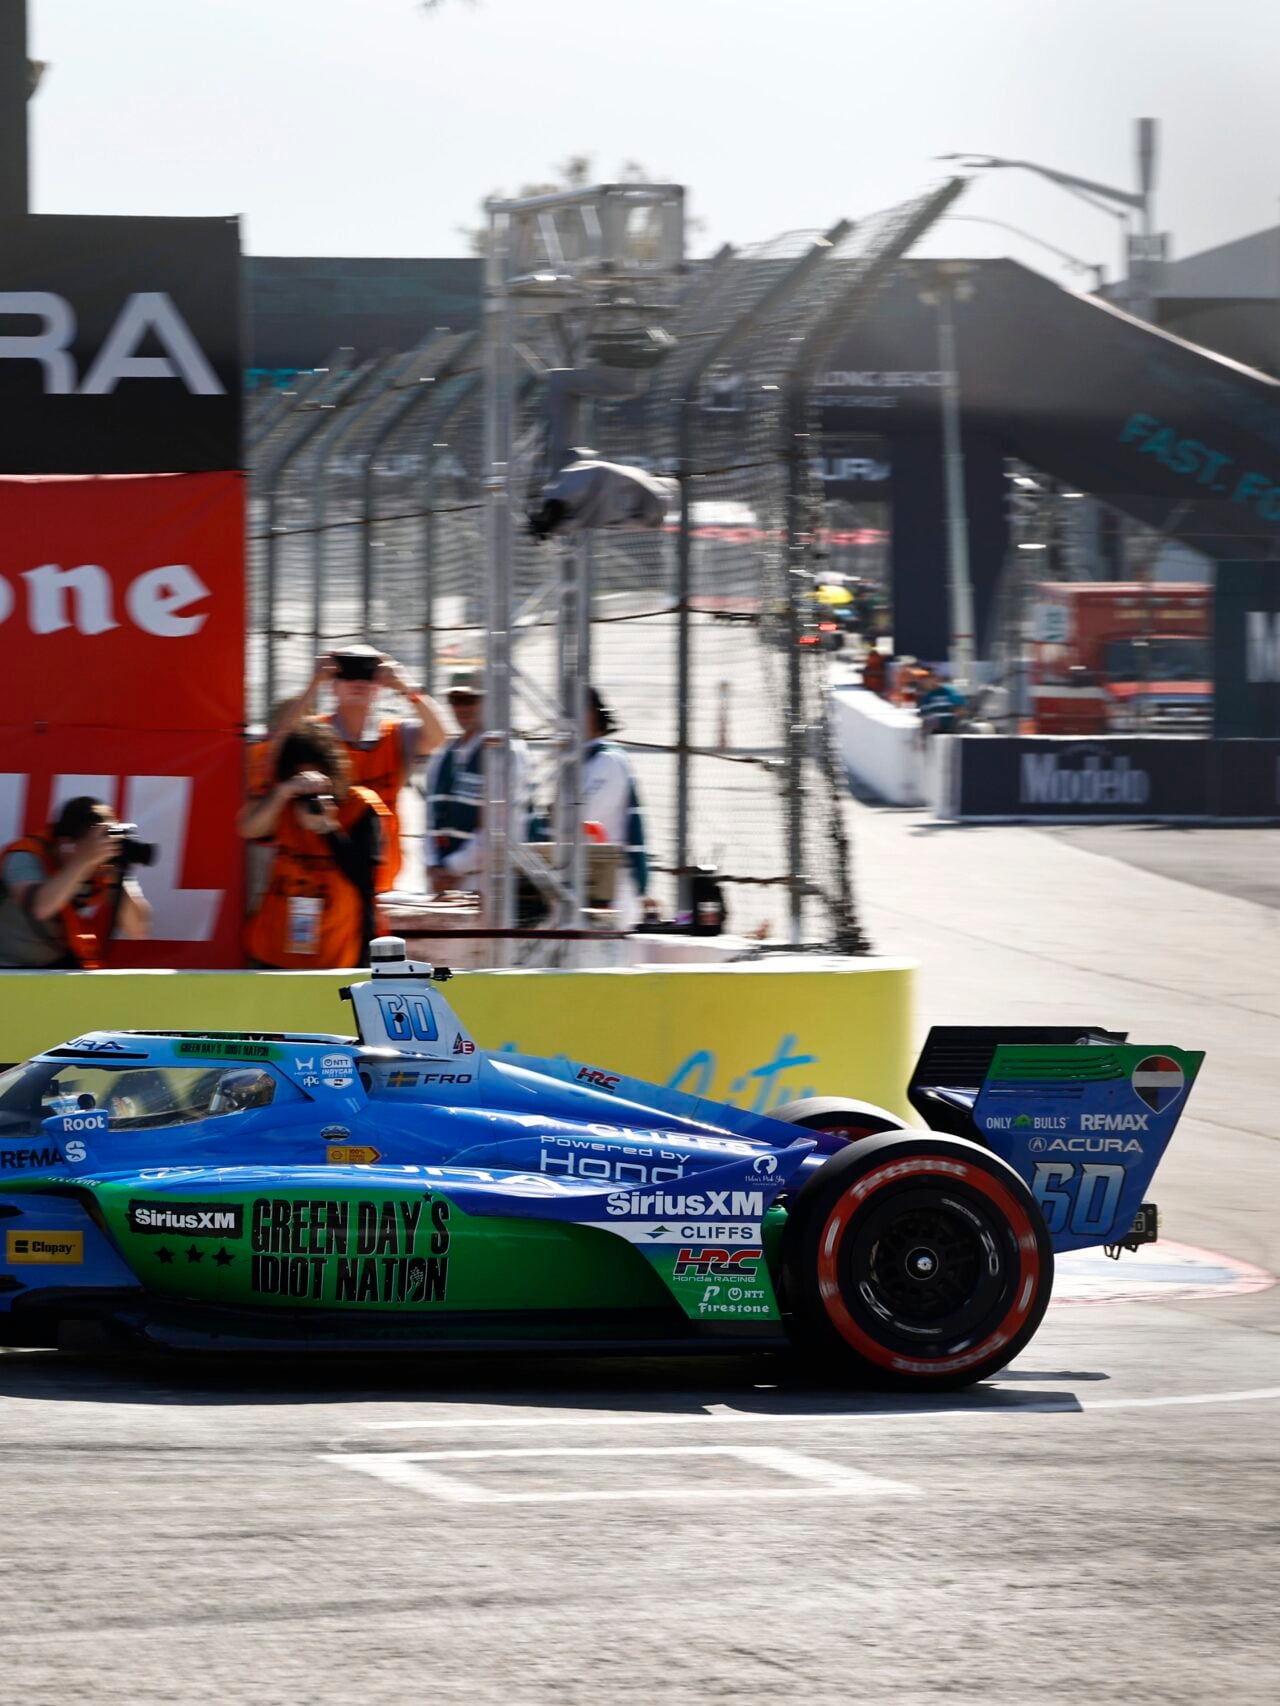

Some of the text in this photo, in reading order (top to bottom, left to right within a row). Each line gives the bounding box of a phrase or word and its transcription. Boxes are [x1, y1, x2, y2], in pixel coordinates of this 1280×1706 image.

[374, 994, 439, 1042] 60
[424, 1074, 472, 1084] FRO
[575, 1068, 621, 1090] HRC
[986, 1117, 1012, 1129] ONLY
[540, 1135, 691, 1163] Powered by
[1047, 1138, 1144, 1153] ACURA
[0, 1148, 65, 1169] REMA
[540, 1149, 704, 1185] Hond
[606, 1191, 763, 1216] SiriusXM
[1032, 1161, 1127, 1236] 60
[135, 1208, 235, 1229] SiriusXM
[251, 1197, 349, 1255] GREEN
[680, 1226, 753, 1239] CLIFFS
[31, 1240, 73, 1255] Clopay
[673, 1248, 763, 1276] HRC
[251, 1255, 449, 1303] IDIOT NATION
[744, 1290, 764, 1298] NTT
[698, 1302, 769, 1316] Firestone
